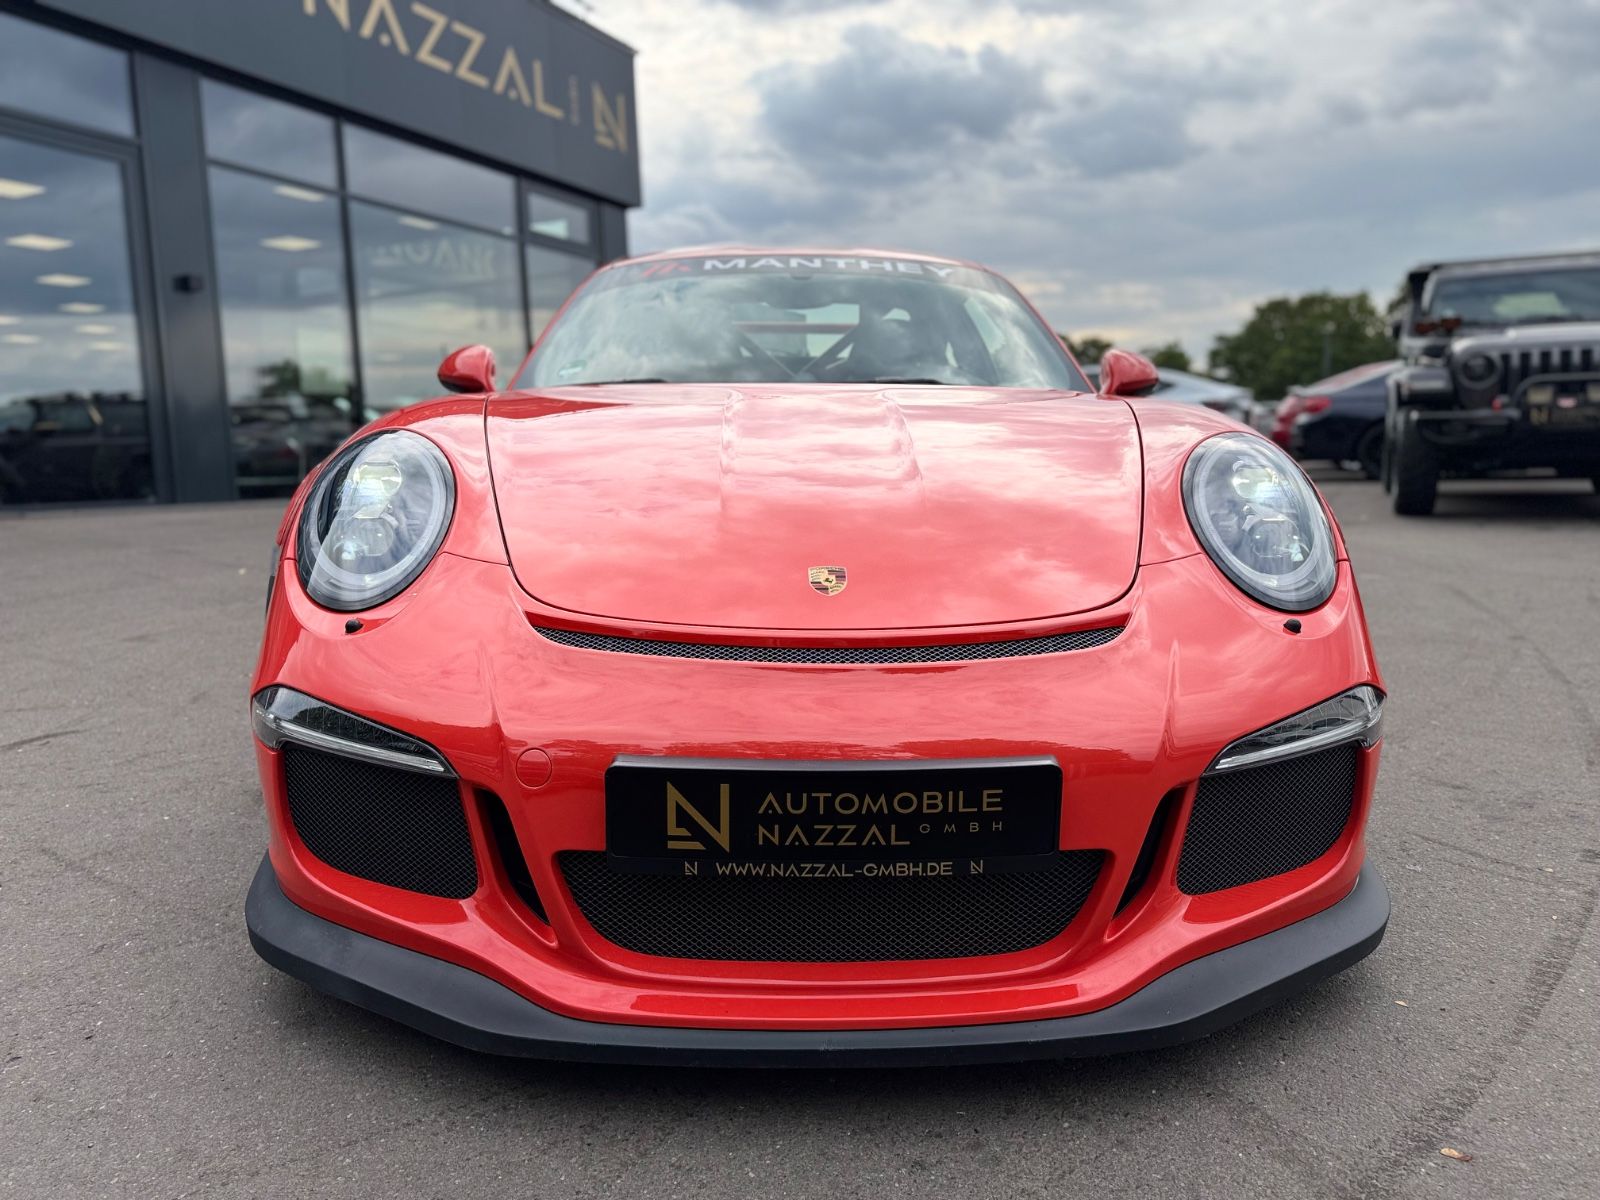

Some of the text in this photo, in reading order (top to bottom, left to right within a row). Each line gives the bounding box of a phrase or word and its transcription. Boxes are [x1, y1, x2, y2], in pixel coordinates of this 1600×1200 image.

[703, 257, 956, 278] MANTHEY
[757, 789, 1004, 815] AUTOMOBILE
[757, 820, 1003, 847] NAZZAL GMBH
[715, 861, 953, 878] WWW.NAZZAL-GMBH.DE
